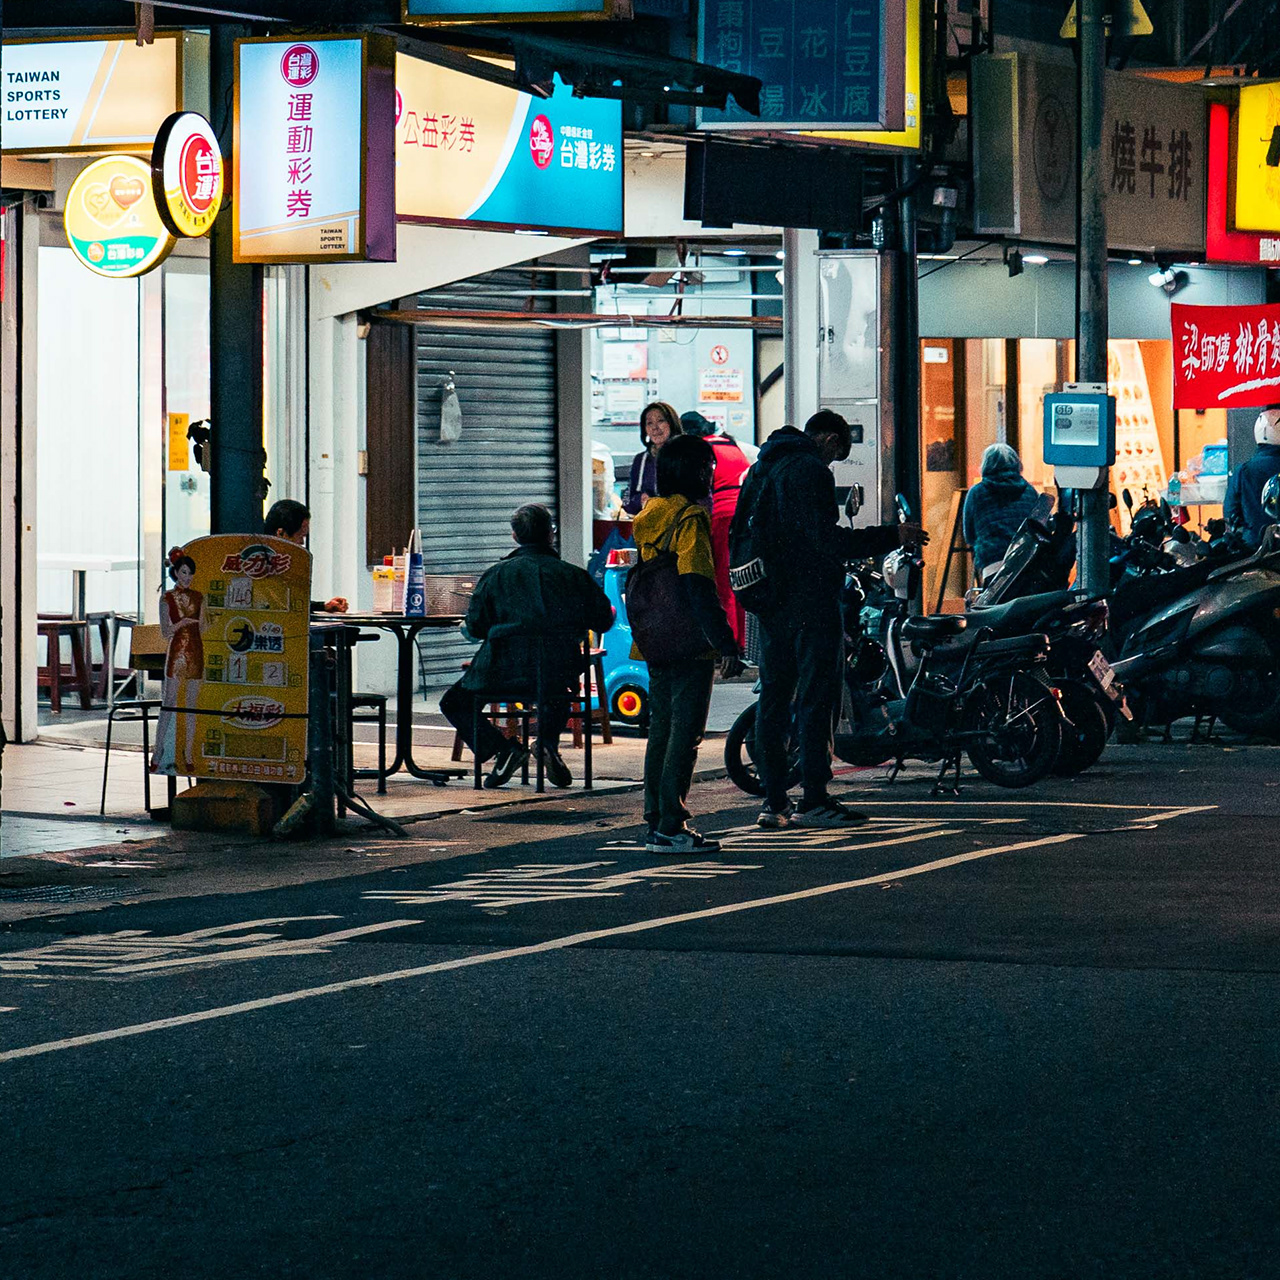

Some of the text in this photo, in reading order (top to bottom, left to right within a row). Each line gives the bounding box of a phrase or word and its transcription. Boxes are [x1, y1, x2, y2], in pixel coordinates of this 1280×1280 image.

[288, 52, 312, 66] 台灣
[7, 70, 60, 83] TAIWAN
[287, 66, 312, 80] 運彩
[7, 89, 61, 102] SPORTS
[7, 108, 69, 121] LOTTERY
[403, 111, 476, 153] 公益彩券
[286, 93, 314, 218] 運動彩券
[560, 140, 616, 172] 台灣彩券
[1110, 120, 1193, 201] 燒牛排
[1057, 405, 1072, 414] 616
[221, 553, 291, 579] 威力彩
[234, 657, 278, 679] 1 2
